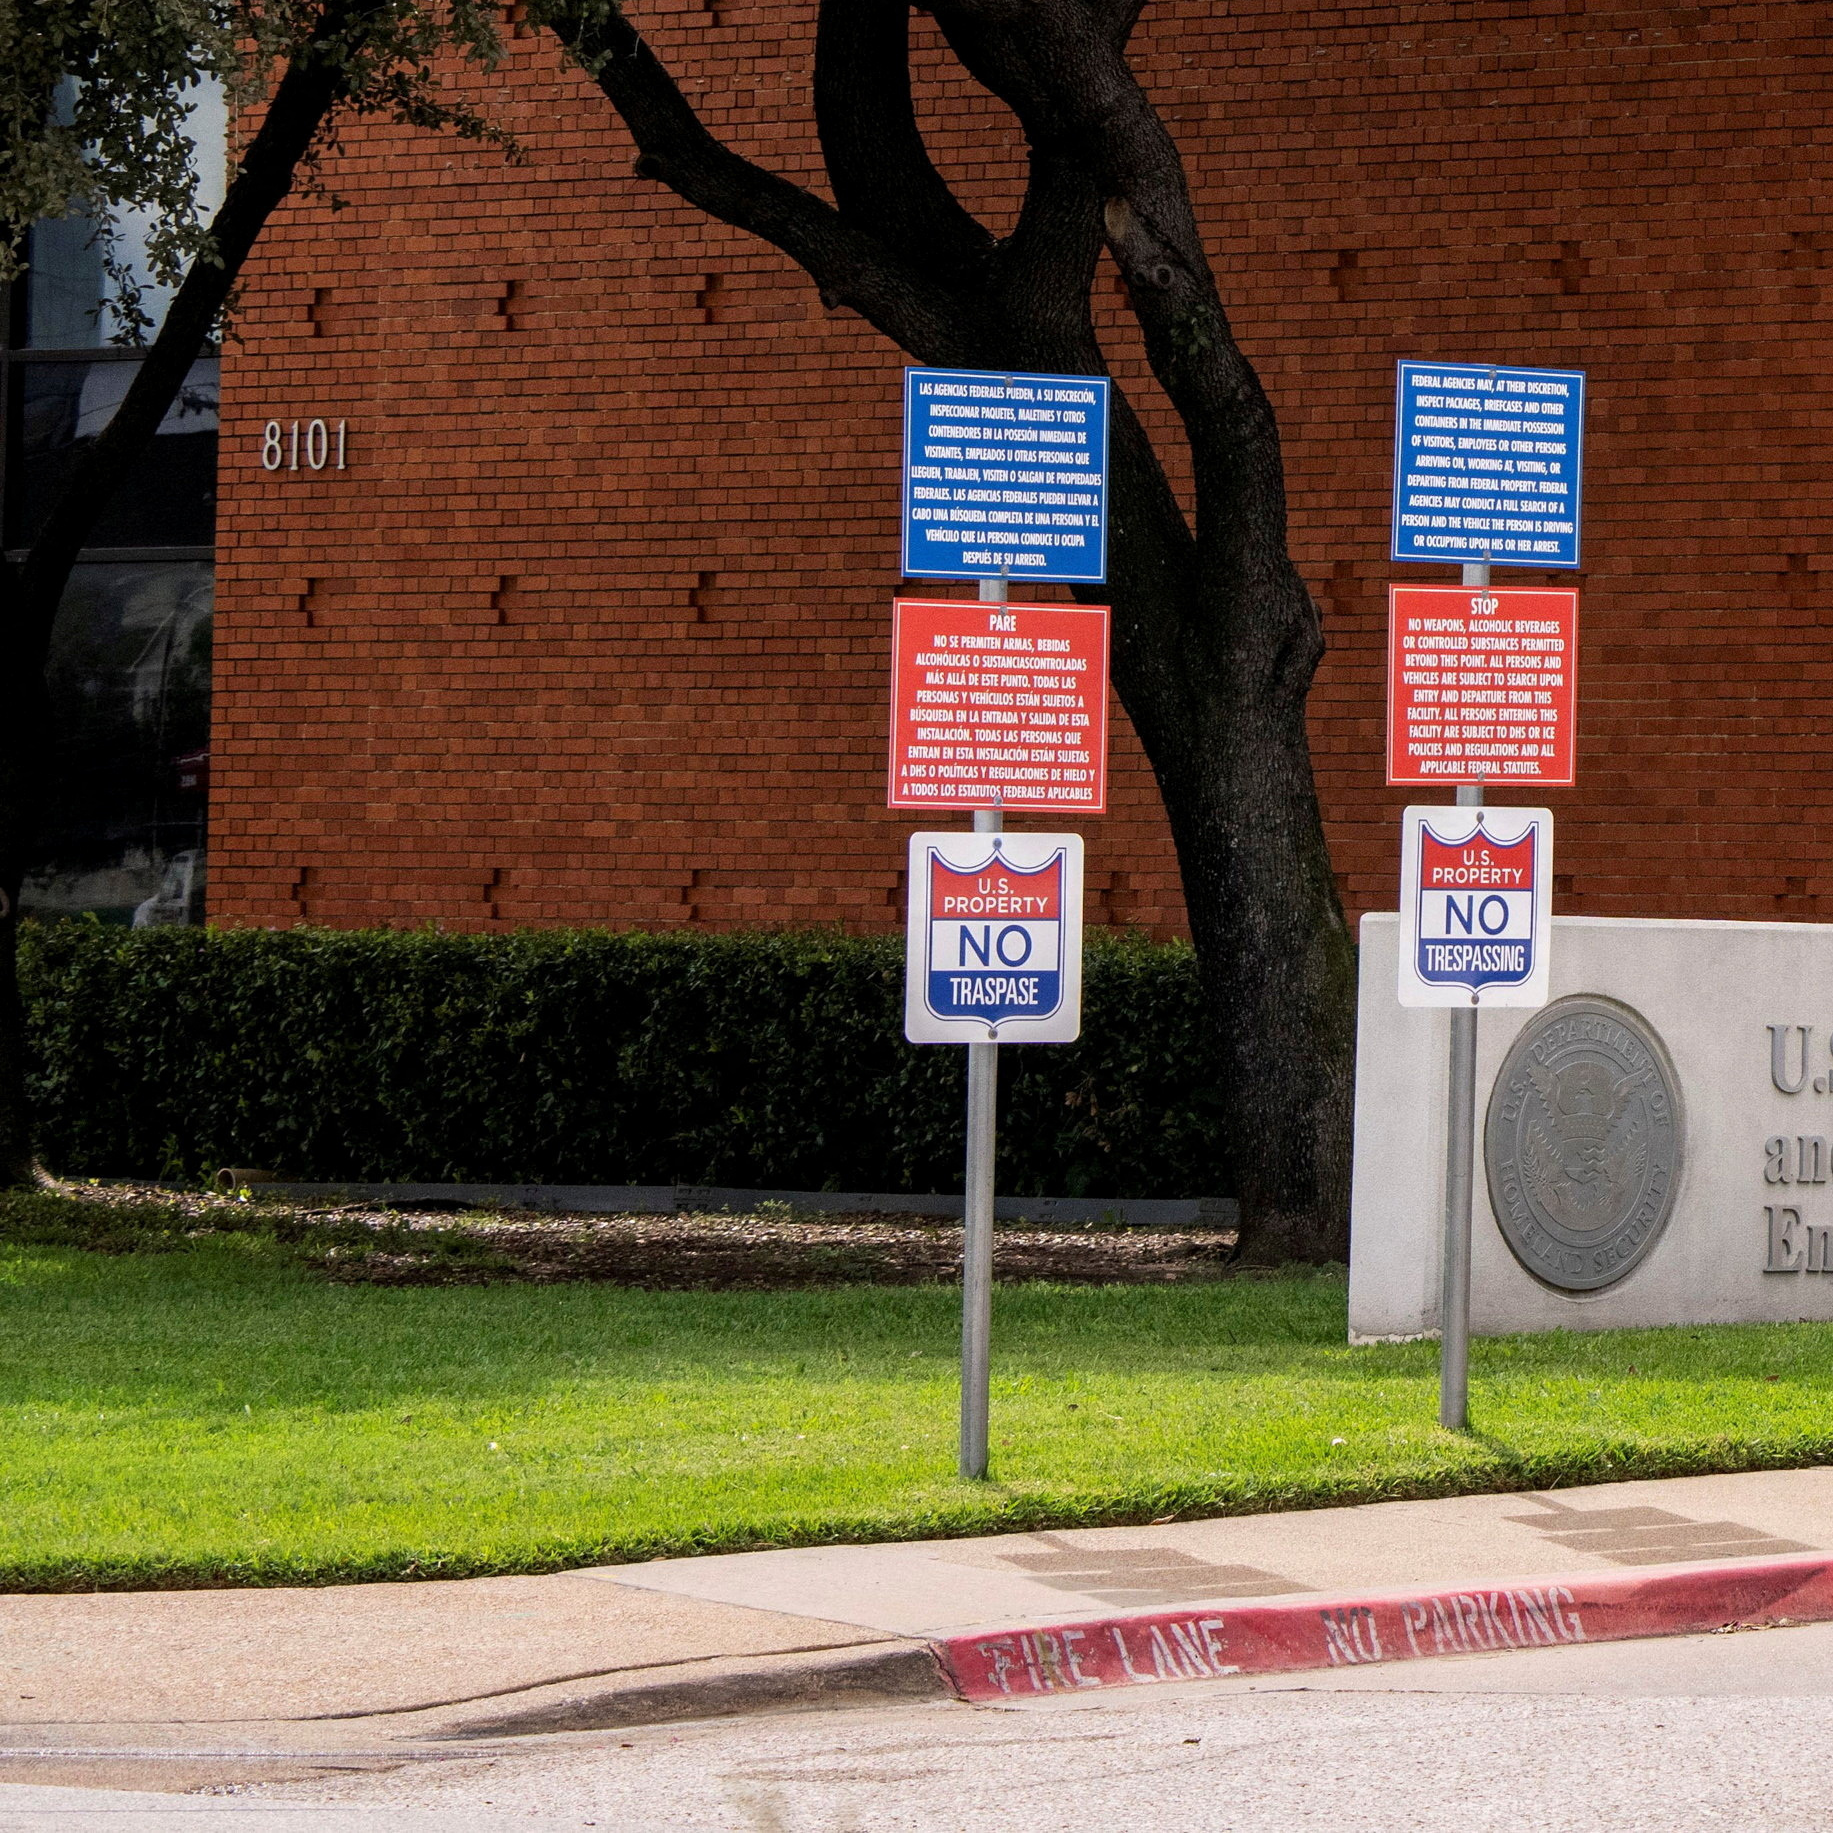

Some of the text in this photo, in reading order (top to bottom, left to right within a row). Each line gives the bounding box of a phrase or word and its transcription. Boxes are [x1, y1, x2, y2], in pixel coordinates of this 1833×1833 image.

[1411, 374, 1569, 398] FEDERAL AGENCIES MAY, AT THEIR DISCRETION,
[1416, 395, 1563, 415] INSPECT PACKAGES, BRIEFCASES AND OTHER
[263, 419, 345, 470] 8101
[1471, 597, 1498, 615] STOP
[989, 615, 1016, 631] PARE
[1408, 618, 1559, 634] NO WEAPONS, ALCOHOLIC BEVERAGES
[933, 635, 1069, 653] NO SE PERMITEN ARMAS, BEBIDAS
[1402, 635, 1564, 651] OR CONTROLLED SUBSTANCES PERMITTED
[915, 650, 1086, 670] ALCOHÓLICAS O SUSTANCIASCONTROLADAS
[1405, 653, 1561, 668] BEYOND THIS POINT. ALL PERSONS AND
[1403, 671, 1563, 686] VEHICLES ARE SUBJECT TO SEARCH UPON
[1413, 689, 1551, 703] ENTRY AND DEPARTURE FROM THIS
[1407, 707, 1557, 721] FACILITY. ALL PERSONS ENTERING THIS
[1409, 725, 1554, 739] FACILITY ARE SUBJECT TO DHS OR ICE
[1408, 742, 1554, 756] POLICIES AND REGULATIONS AND ALL
[1420, 760, 1541, 774] APPLICABLE FEDERAL STATUTES.
[1463, 850, 1495, 866] U.S.
[1432, 868, 1523, 884] PROPERTY
[978, 878, 1014, 894] U.S.
[944, 897, 1048, 913] PROPERTY
[1446, 895, 1509, 935] NO
[959, 924, 1032, 967] NO
[1426, 945, 1524, 972] TRESPASSING
[950, 977, 1039, 1005] TRASPASE
[977, 1585, 1586, 1695] FIRE LANE NO PARKING
